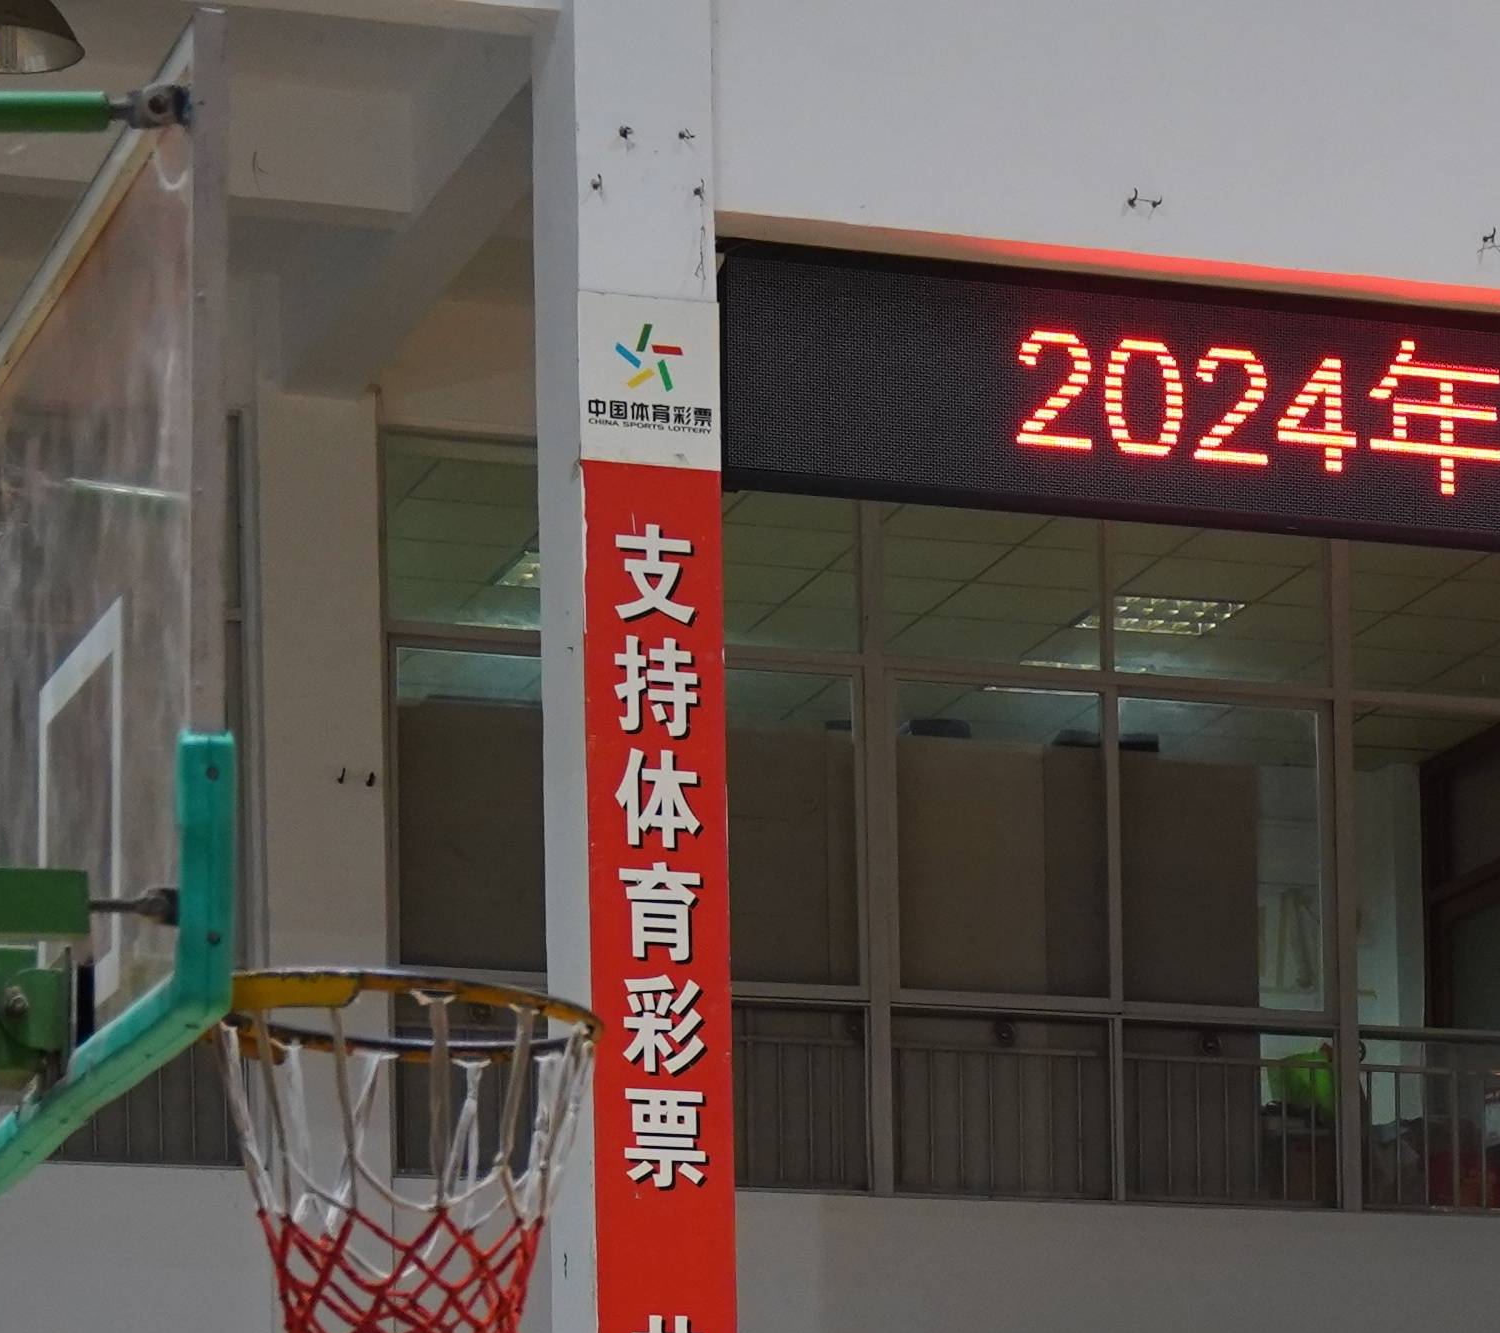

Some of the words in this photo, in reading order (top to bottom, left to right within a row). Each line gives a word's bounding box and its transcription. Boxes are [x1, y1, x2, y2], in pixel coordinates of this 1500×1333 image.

[588, 398, 713, 427] 中国体育彩票
[588, 417, 619, 427] CHINA
[623, 420, 665, 431] SPORTS
[668, 425, 712, 435] LOTTERY
[613, 522, 710, 1190] 支持体育彩票
